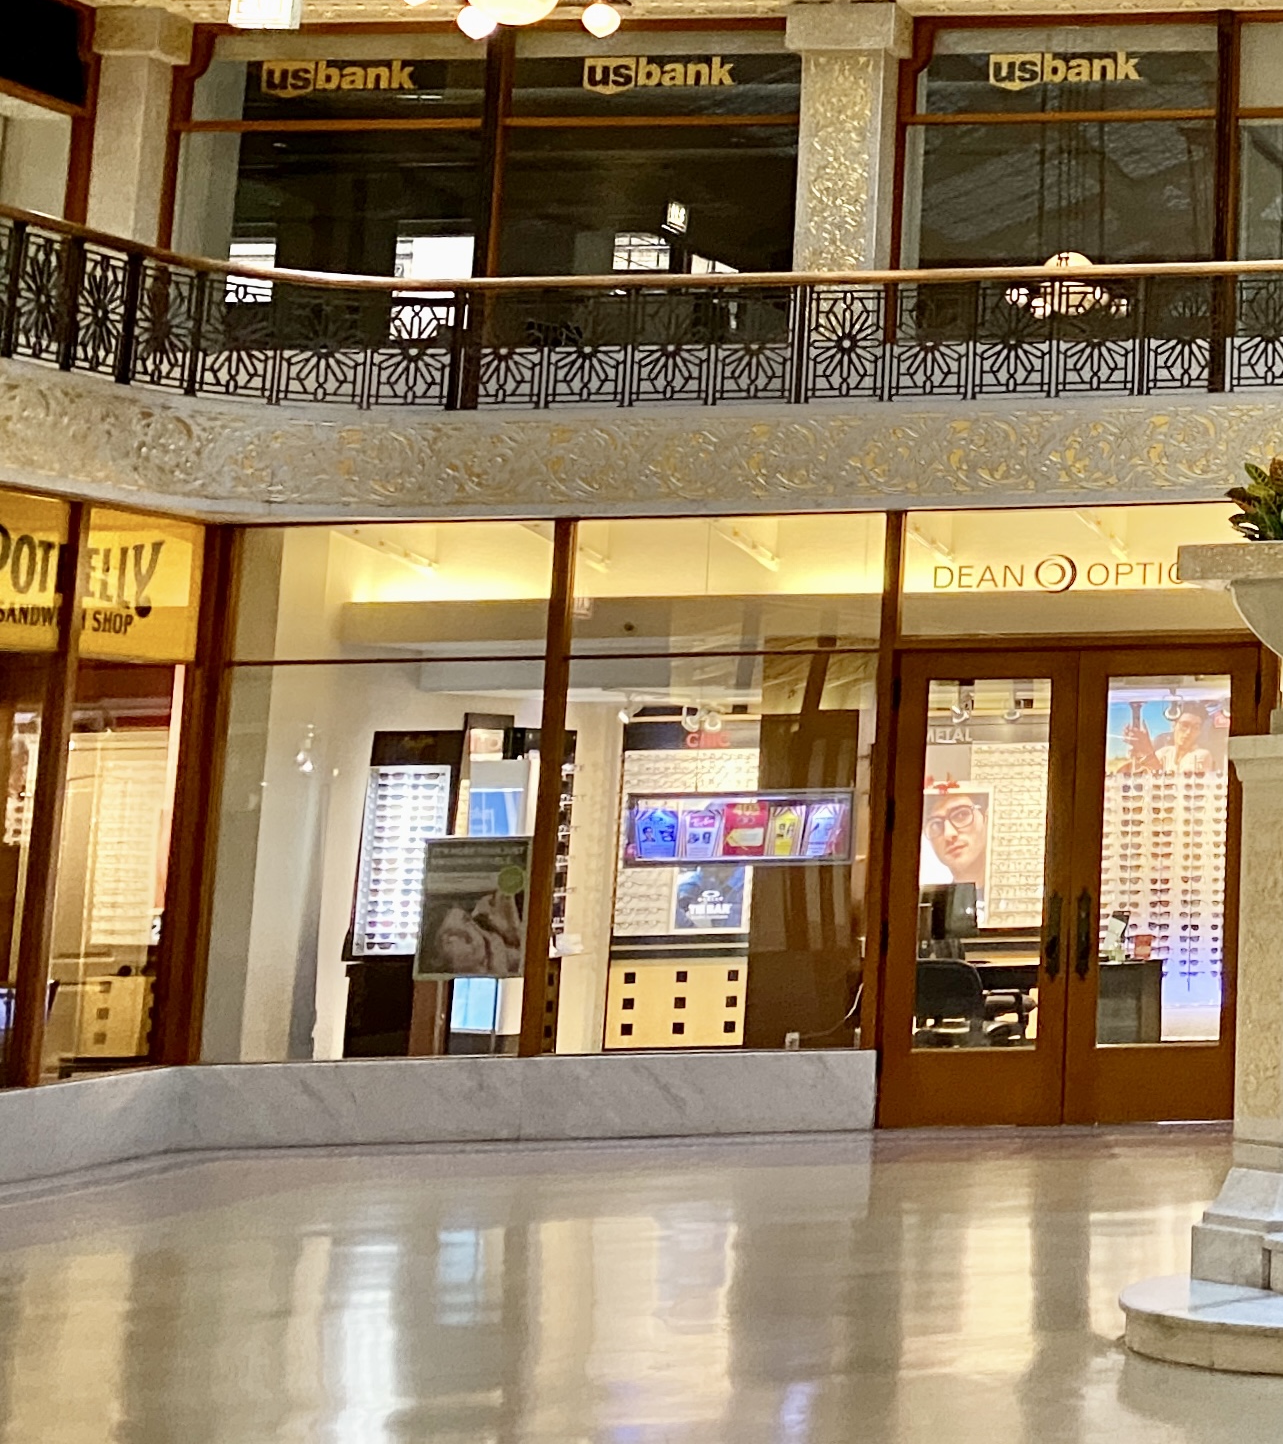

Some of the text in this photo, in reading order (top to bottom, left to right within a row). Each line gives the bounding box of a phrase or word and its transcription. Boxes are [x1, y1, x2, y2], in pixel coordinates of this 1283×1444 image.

[260, 60, 415, 98] usbank
[583, 56, 735, 95] usbank
[988, 51, 1143, 91] usbank
[933, 561, 1185, 589] DEAN OPTIC
[92, 609, 134, 636] SHOP
